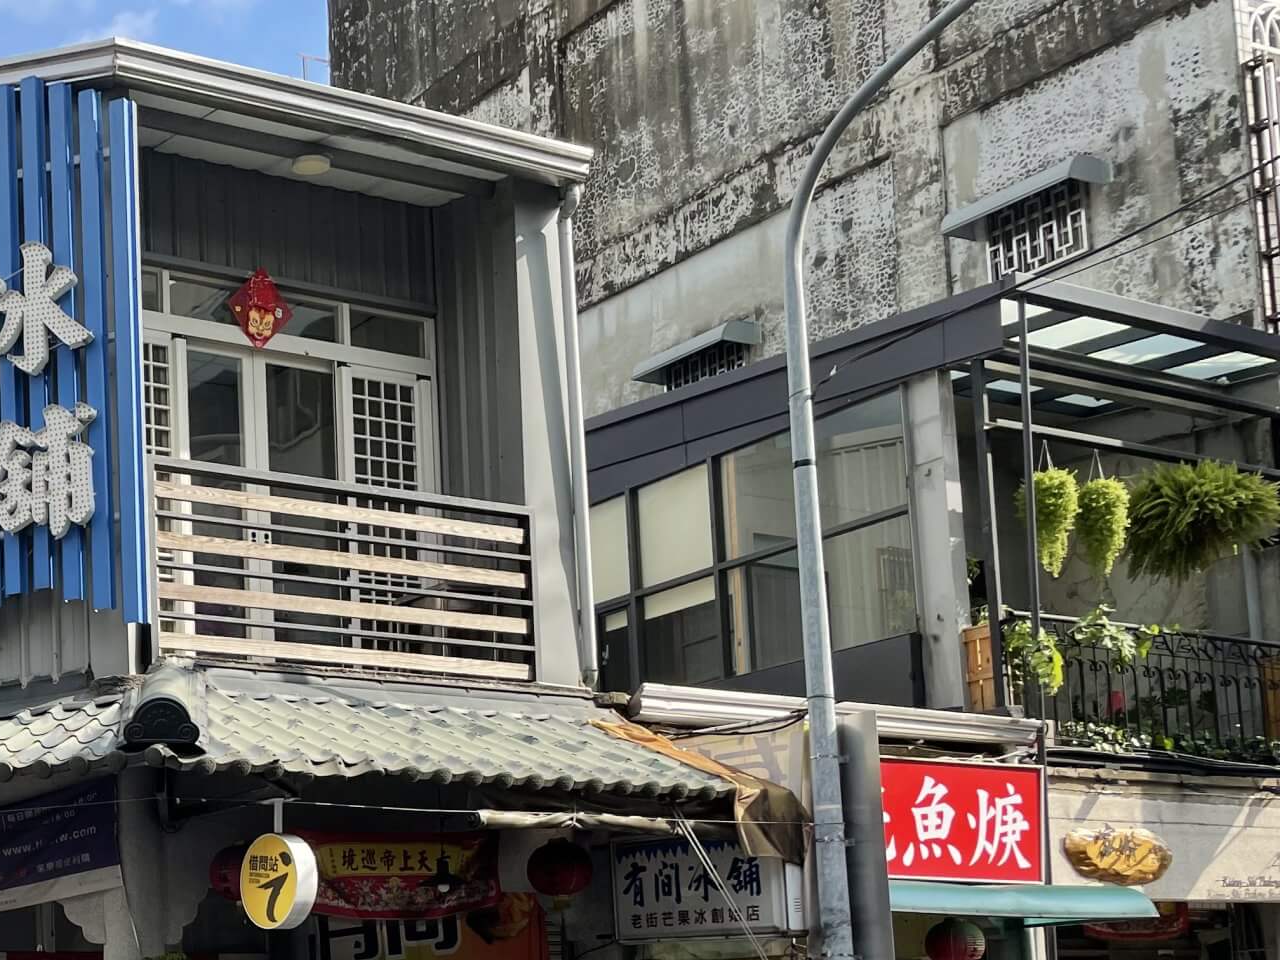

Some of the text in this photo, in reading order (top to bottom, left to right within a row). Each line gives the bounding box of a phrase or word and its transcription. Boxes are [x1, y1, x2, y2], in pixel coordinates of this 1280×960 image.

[880, 775, 1032, 870] 魚焿
[249, 855, 279, 872] 借問站
[631, 905, 760, 930] 老街芒果冰創始店
